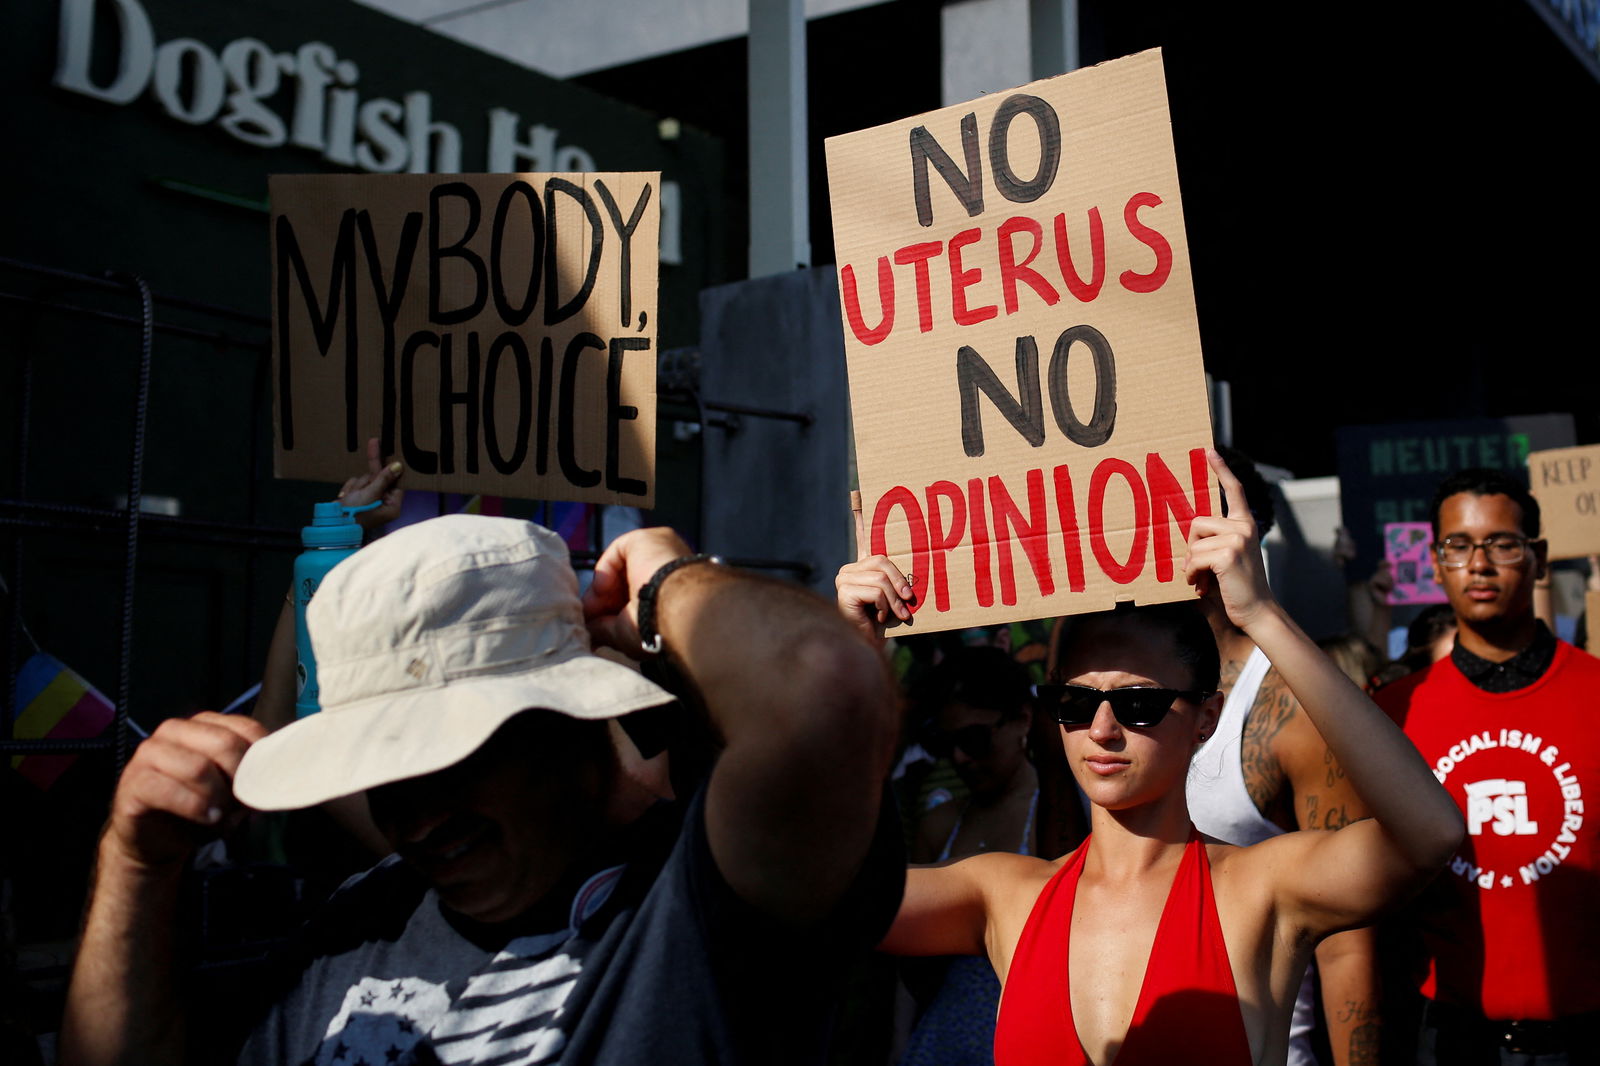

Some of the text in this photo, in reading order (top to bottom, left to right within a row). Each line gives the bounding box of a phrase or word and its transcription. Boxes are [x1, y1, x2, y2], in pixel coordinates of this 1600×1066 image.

[52, 0, 463, 174] Dogfish
[910, 93, 1062, 227] NO
[275, 177, 653, 456] MY BODY,
[841, 192, 1173, 346] UTERUS
[401, 330, 651, 497] CHOICE
[957, 324, 1118, 458] NO
[1369, 433, 1530, 476] NEUTER
[871, 448, 1213, 614] OPINION
[1467, 794, 1538, 836] PSL
[1539, 745, 1558, 766] &
[1447, 854, 1495, 890] PAR
[1519, 762, 1585, 885] LIBERATION
